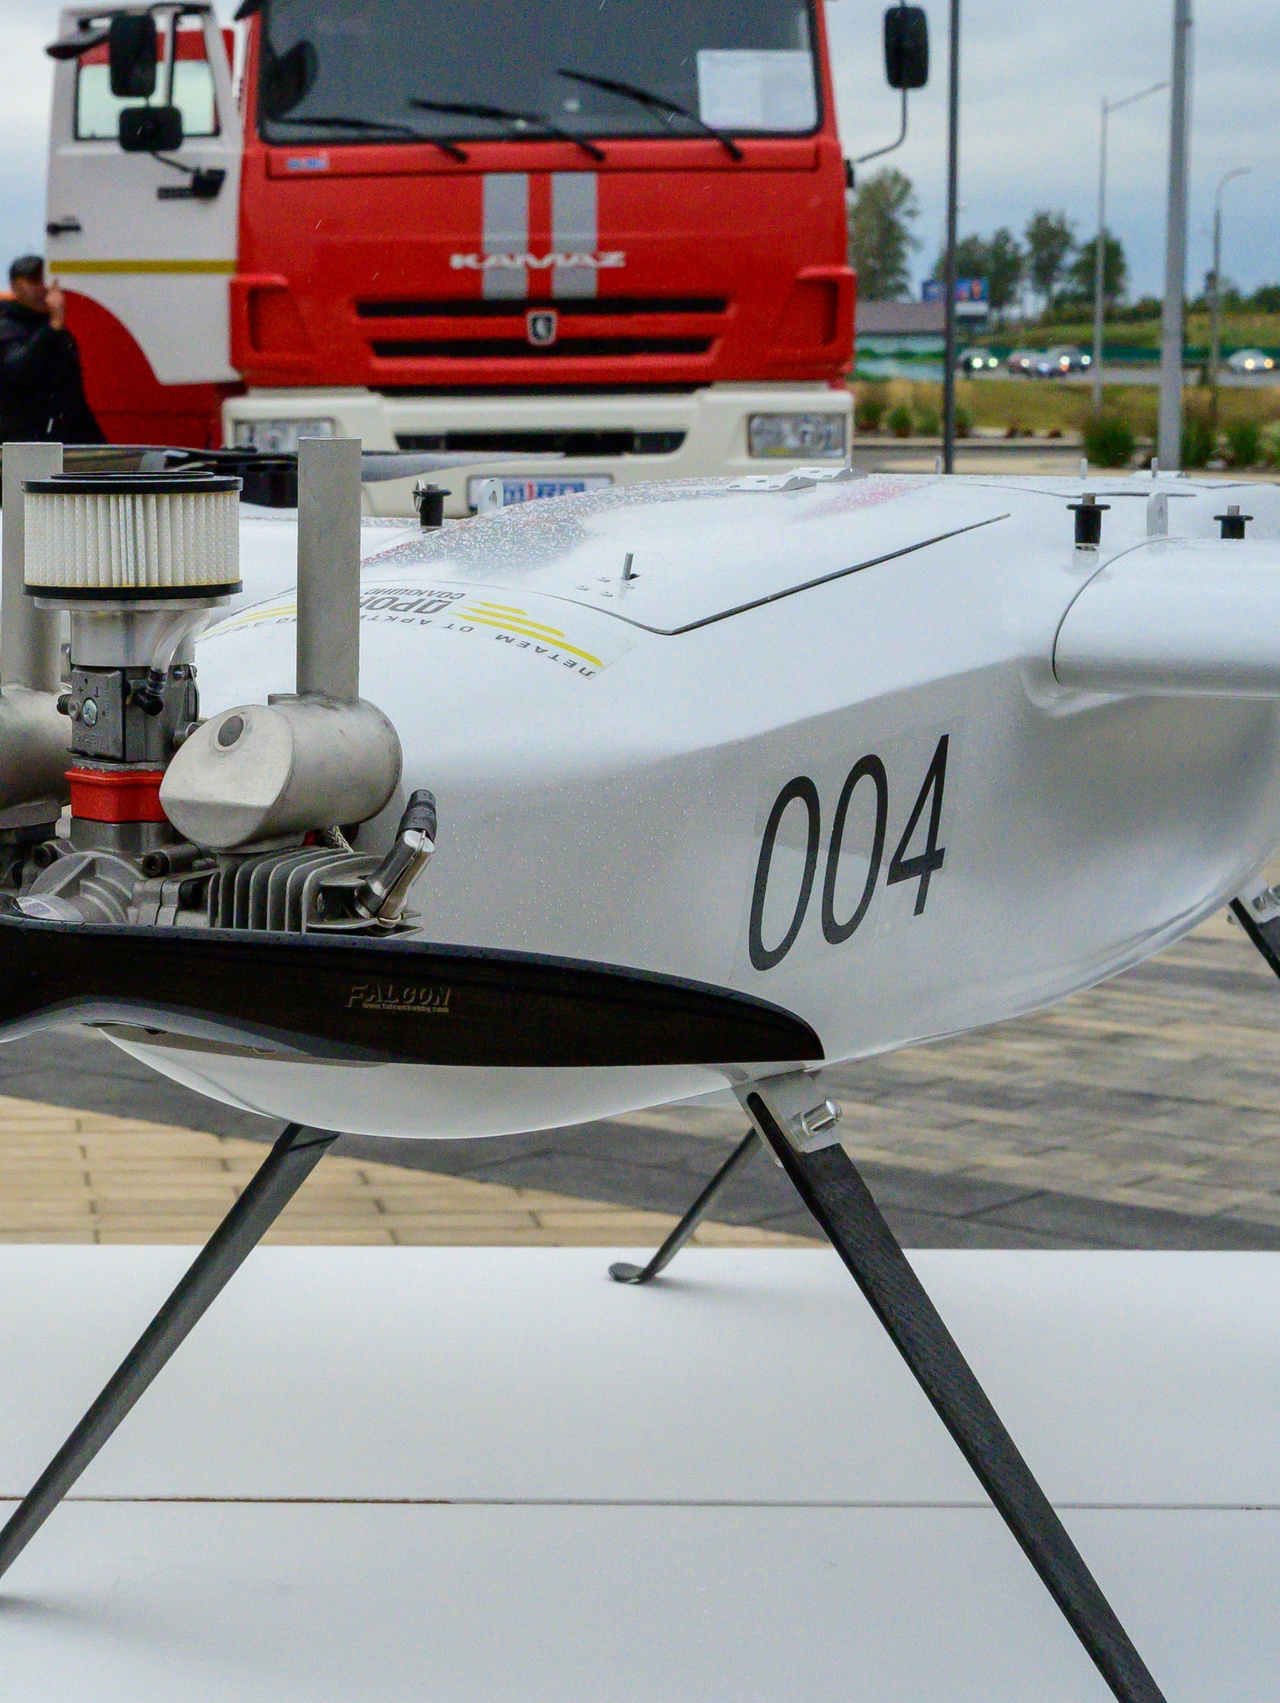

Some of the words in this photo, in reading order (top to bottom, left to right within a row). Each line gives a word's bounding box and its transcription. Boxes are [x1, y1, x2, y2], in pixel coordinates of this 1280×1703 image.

[450, 251, 626, 270] KAMAZ
[443, 623, 474, 633] ОТ
[494, 634, 595, 677] ЛЕТАЕМ
[748, 733, 950, 972] 004
[344, 984, 451, 1008] FALCON
